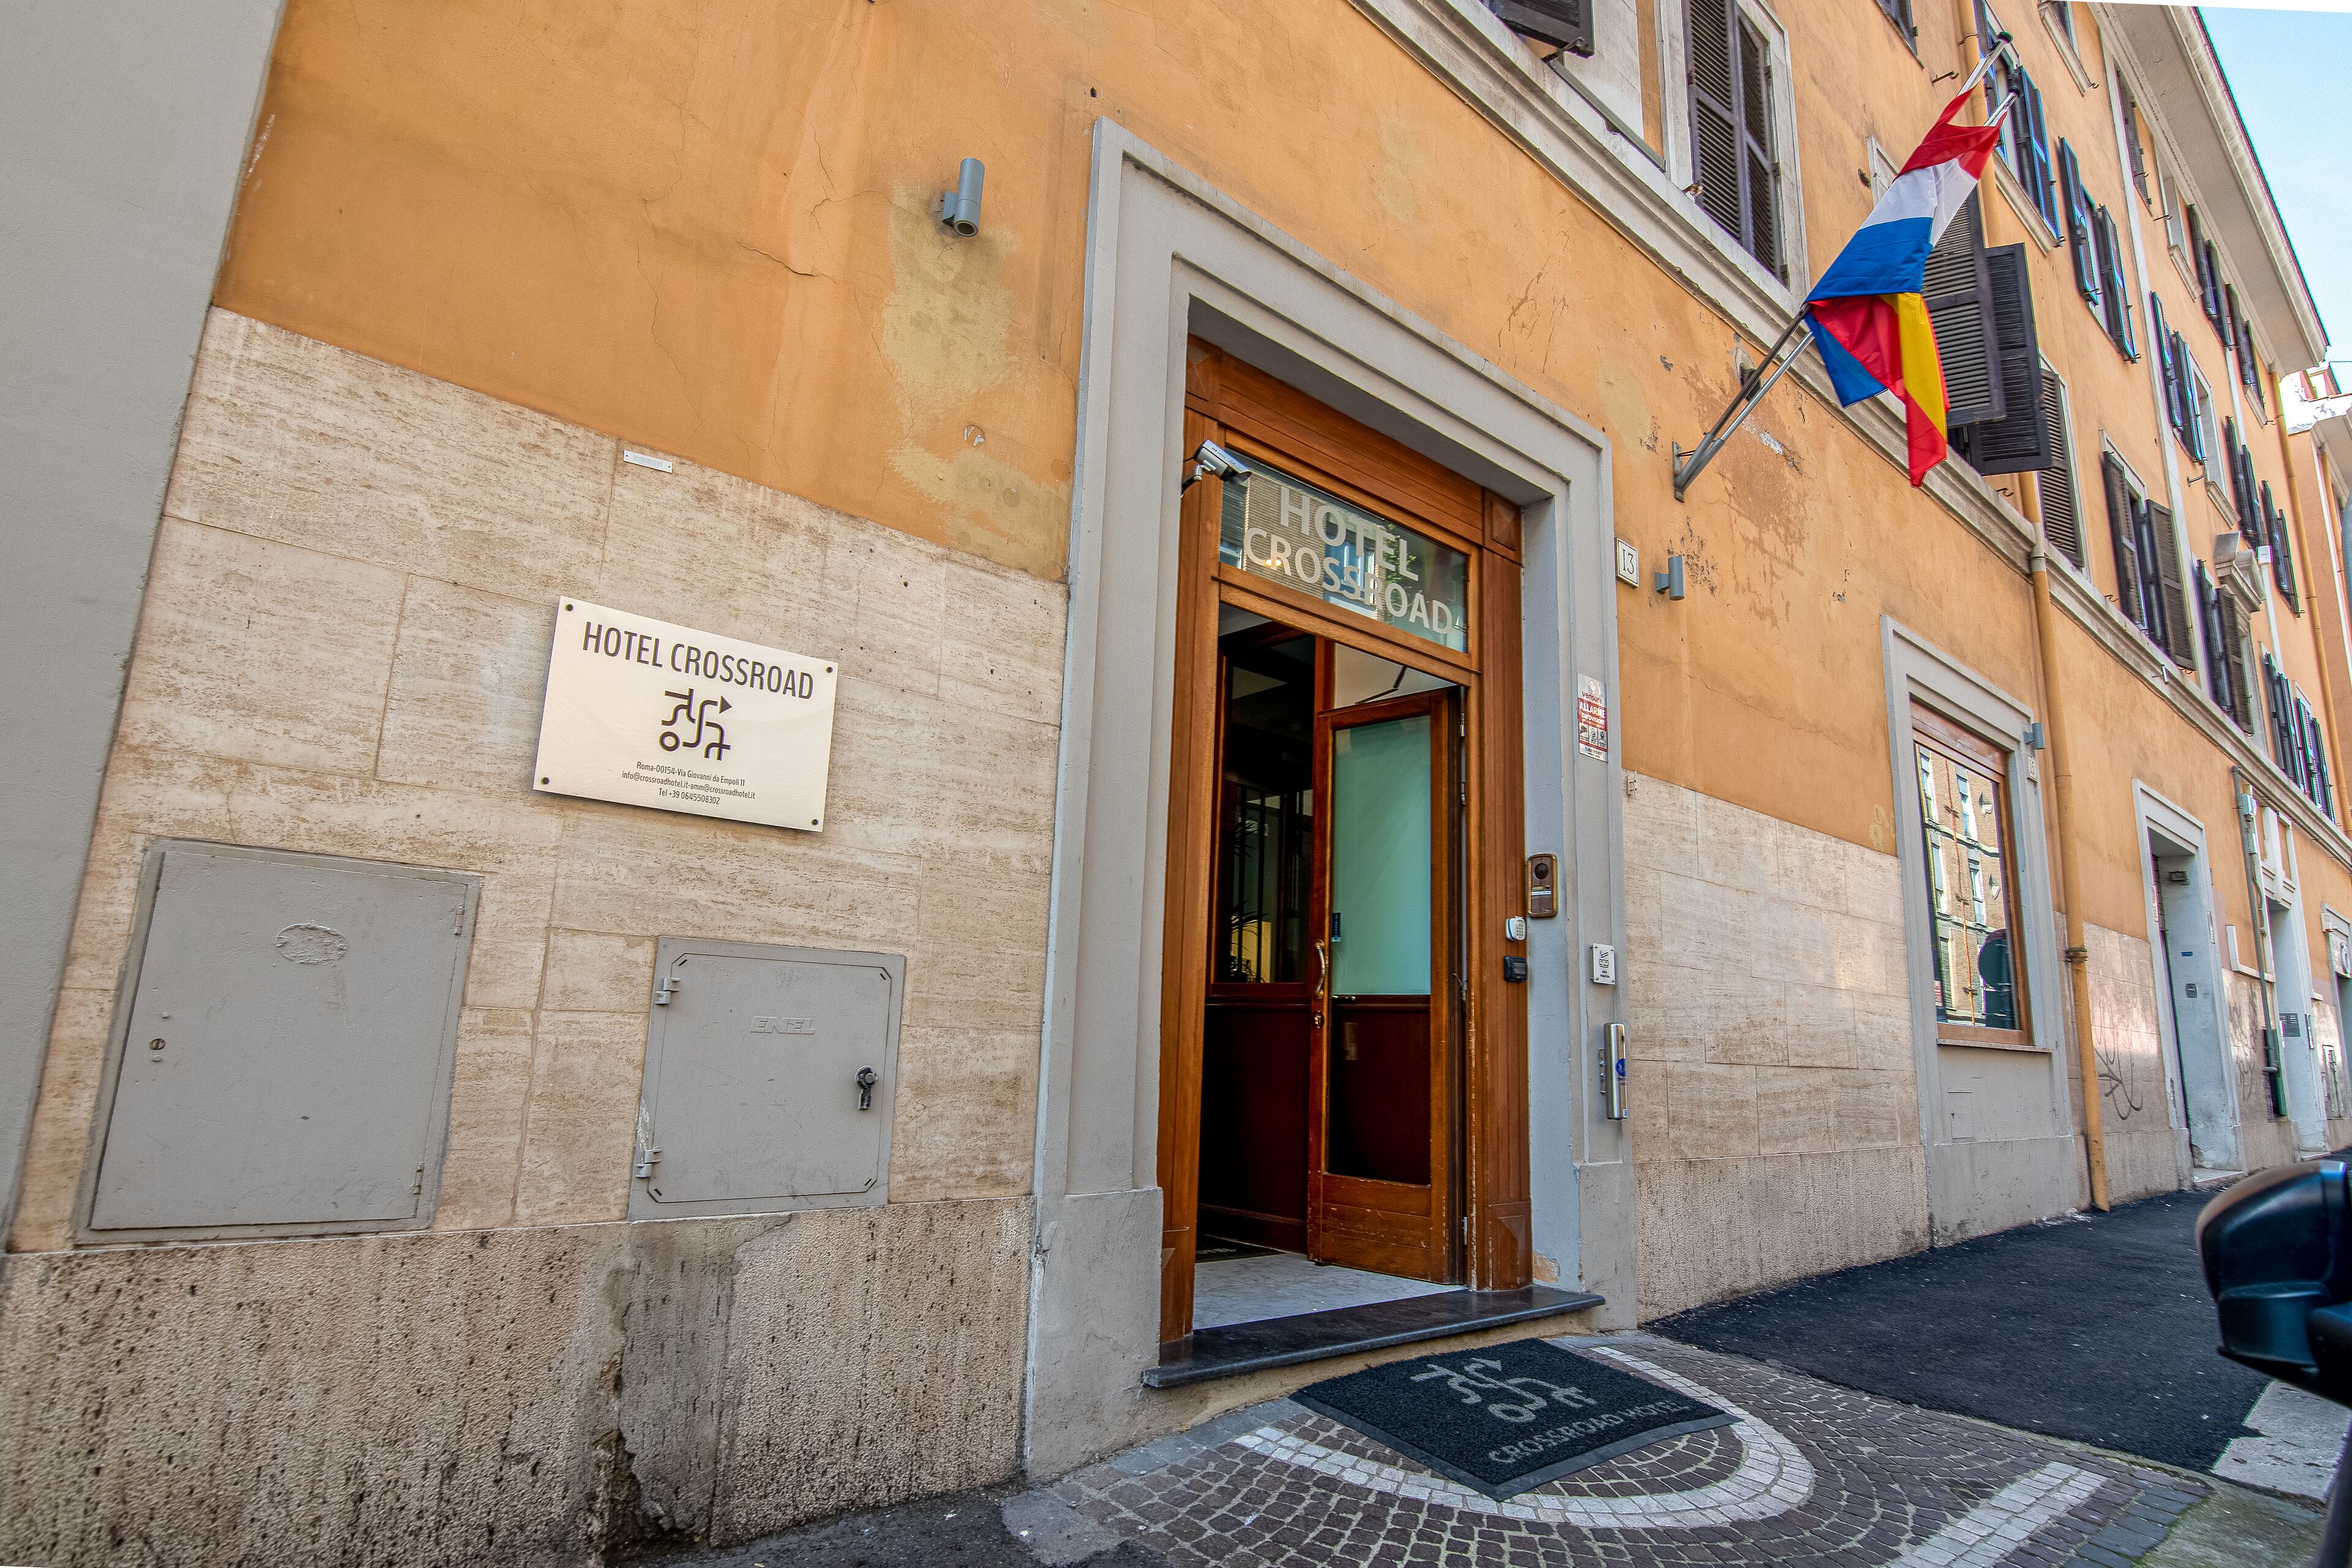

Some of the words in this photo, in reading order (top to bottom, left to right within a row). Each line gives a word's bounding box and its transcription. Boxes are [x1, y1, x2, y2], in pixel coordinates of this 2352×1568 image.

[1280, 484, 1419, 581] HOTEL
[1622, 549, 1635, 575] 13
[1243, 527, 1452, 635] CROSSROAD
[582, 621, 663, 668] HOTEL
[671, 643, 813, 699] CROSSROAD
[1579, 701, 1605, 718] ALLARME
[636, 761, 686, 777] Roma-00154-Via
[687, 770, 712, 782] Giovanni
[712, 774, 720, 783] da
[720, 775, 739, 786] Empoli
[659, 788, 668, 797] Tel
[669, 790, 680, 799] +39
[681, 792, 720, 804] 0645508302
[750, 1016, 815, 1035] ENEL
[1488, 1414, 1624, 1464] CROSSROAD
